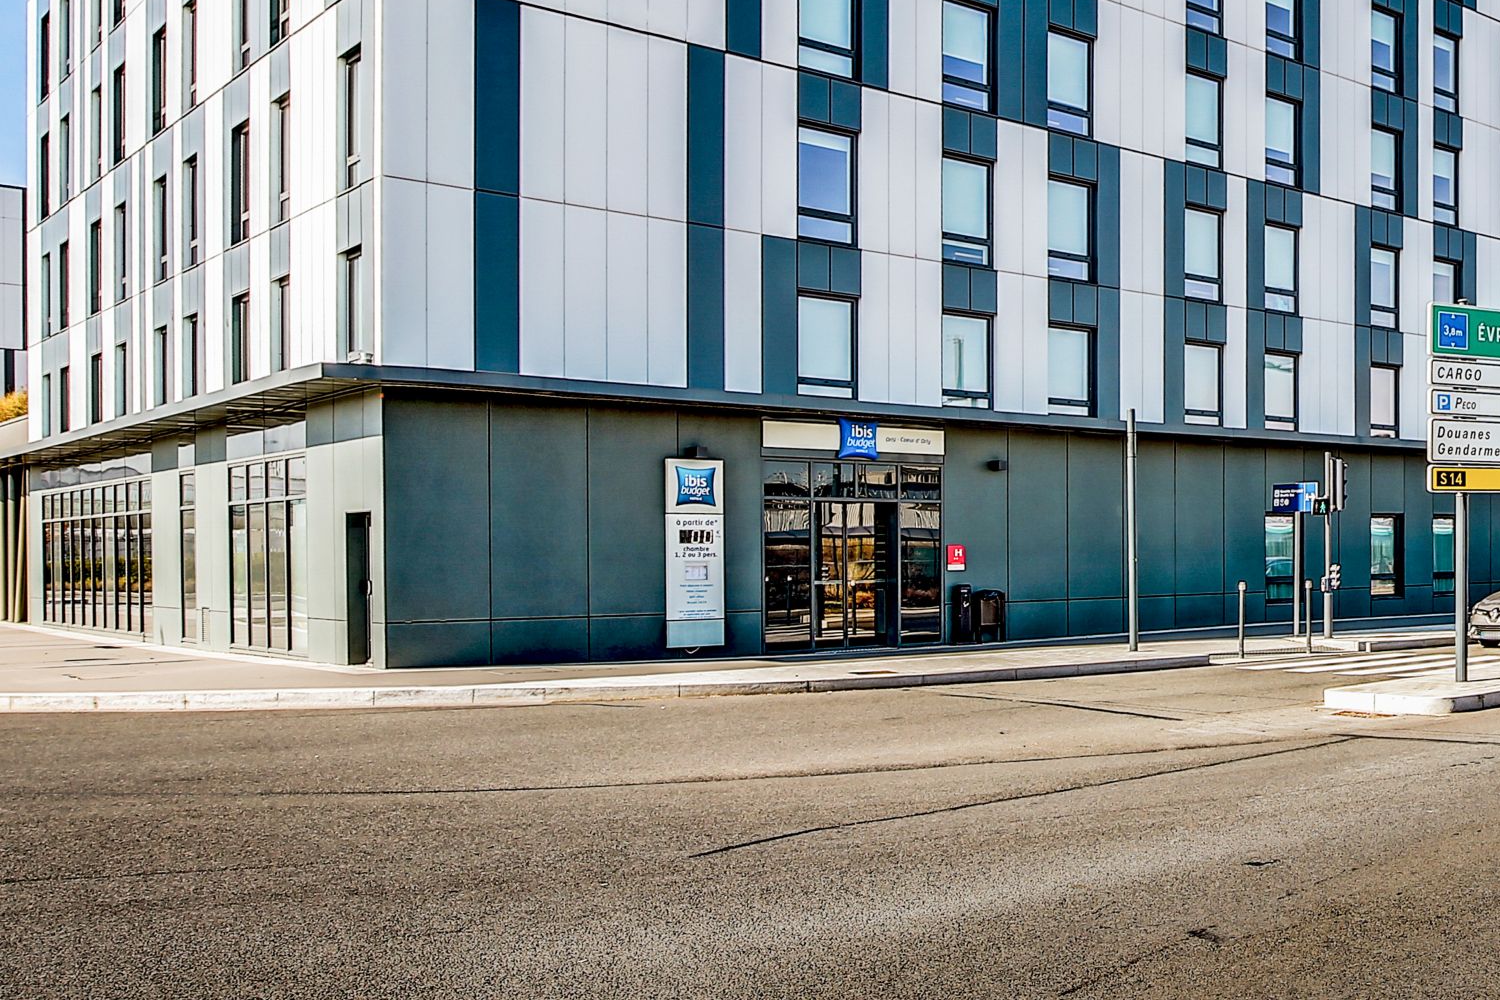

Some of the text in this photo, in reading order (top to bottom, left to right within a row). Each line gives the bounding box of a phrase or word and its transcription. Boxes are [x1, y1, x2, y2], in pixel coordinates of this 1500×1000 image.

[1437, 366, 1482, 381] CARGO
[1439, 396, 1449, 409] P
[851, 424, 873, 438] ibis
[1437, 426, 1491, 440] Douanes
[847, 437, 875, 449] budget
[684, 474, 707, 487] ibis
[681, 485, 710, 496] budget
[954, 548, 963, 557] H
